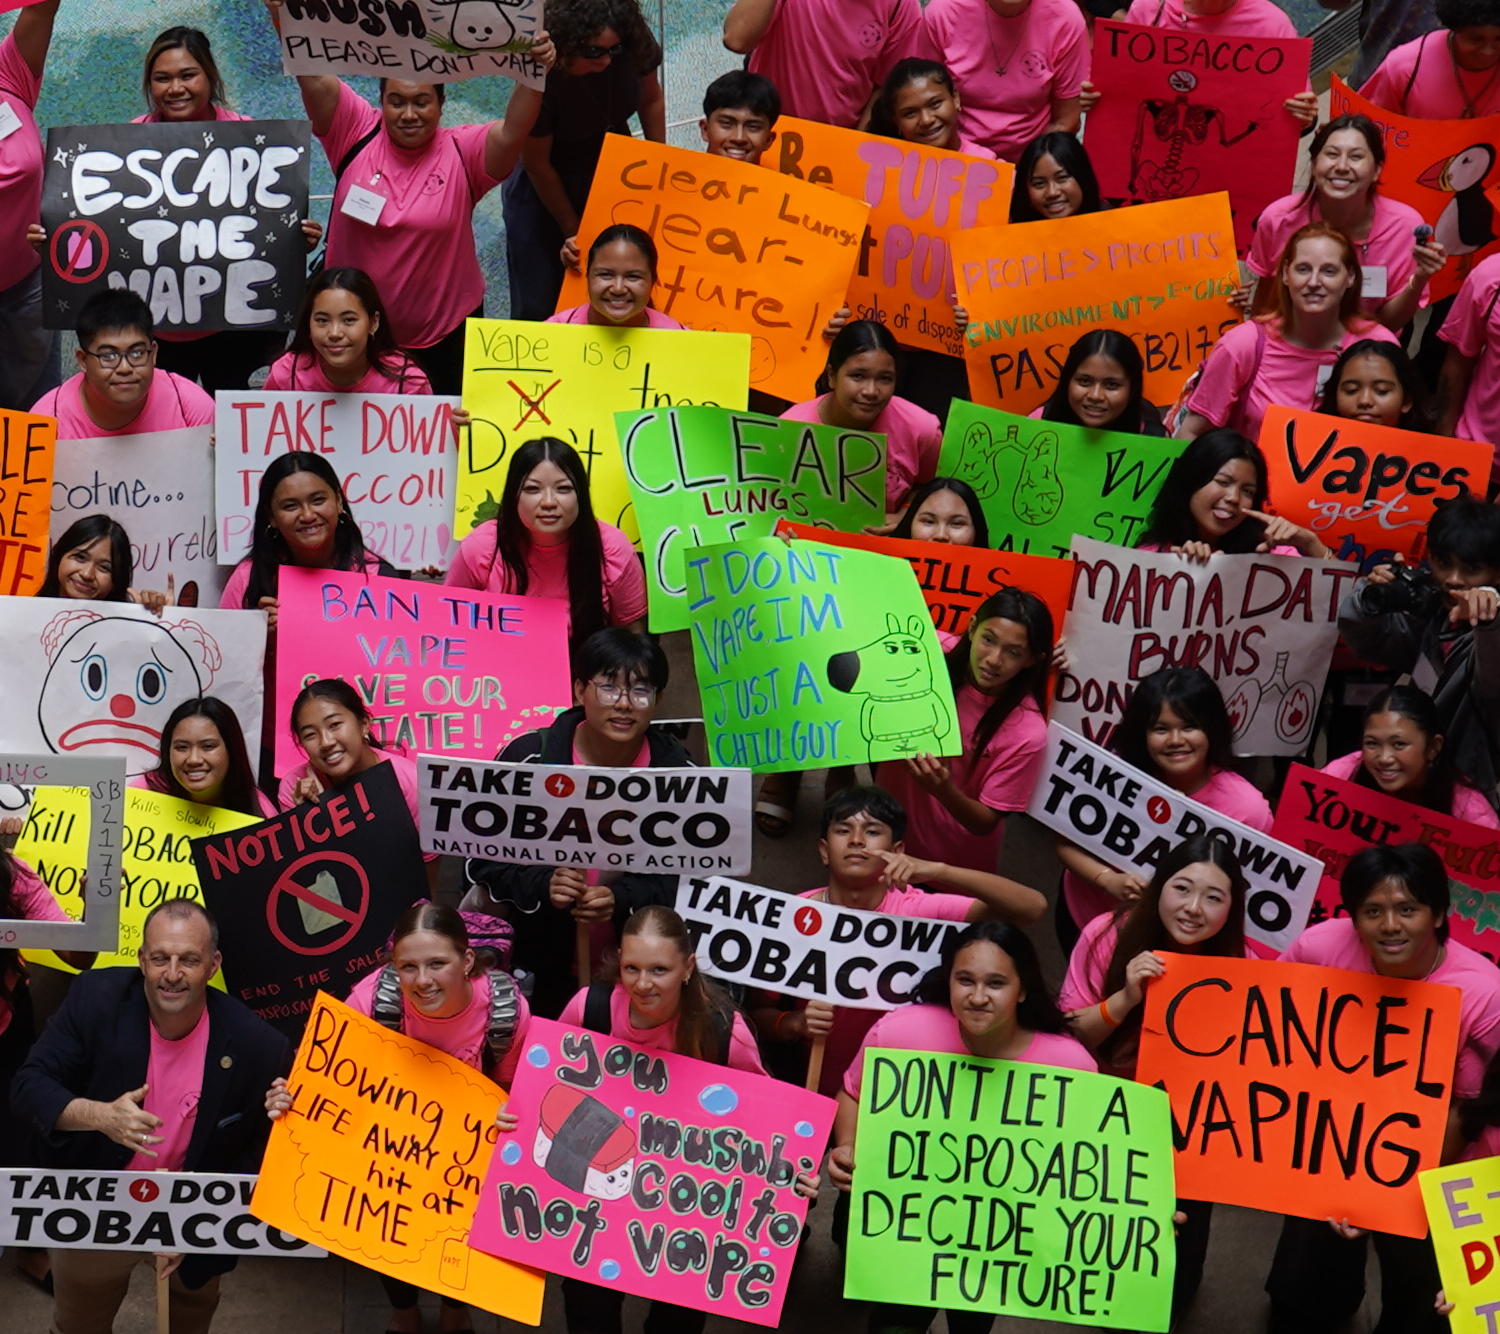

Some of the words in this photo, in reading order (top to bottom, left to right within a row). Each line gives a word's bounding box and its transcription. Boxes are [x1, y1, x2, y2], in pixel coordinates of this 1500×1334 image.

[1107, 27, 1284, 75] TOBACCO
[72, 145, 302, 216] ESCAPE
[857, 140, 999, 229] TUFF
[133, 216, 258, 265] THE
[625, 411, 885, 510] CLEAR
[702, 486, 809, 518] LUNGS
[322, 583, 418, 622] BAN
[444, 598, 525, 636] THE
[356, 634, 467, 669] VAPE
[424, 675, 507, 710] OUR
[427, 765, 534, 796] TAKE
[585, 772, 727, 804] DOWN
[1056, 739, 1143, 810] TAKE
[430, 798, 731, 849] TOBACCO
[432, 838, 546, 862] NATIONAL
[555, 848, 597, 866] DAY
[607, 852, 636, 867] OF
[645, 853, 732, 870] ACTION
[689, 878, 787, 928] TAKE
[1166, 977, 1445, 1100] CANCEL
[870, 1058, 995, 1121] DON'T
[1002, 1070, 1073, 1128] LET
[1098, 1087, 1131, 1135] A
[9, 1175, 119, 1203] TAKE
[888, 1131, 1150, 1207] DISPOSABLE
[319, 1170, 413, 1246] TIME
[862, 1191, 1035, 1257] DECIDE
[1056, 1206, 1160, 1277] YOUR
[930, 1253, 1115, 1317] FUTURE!
